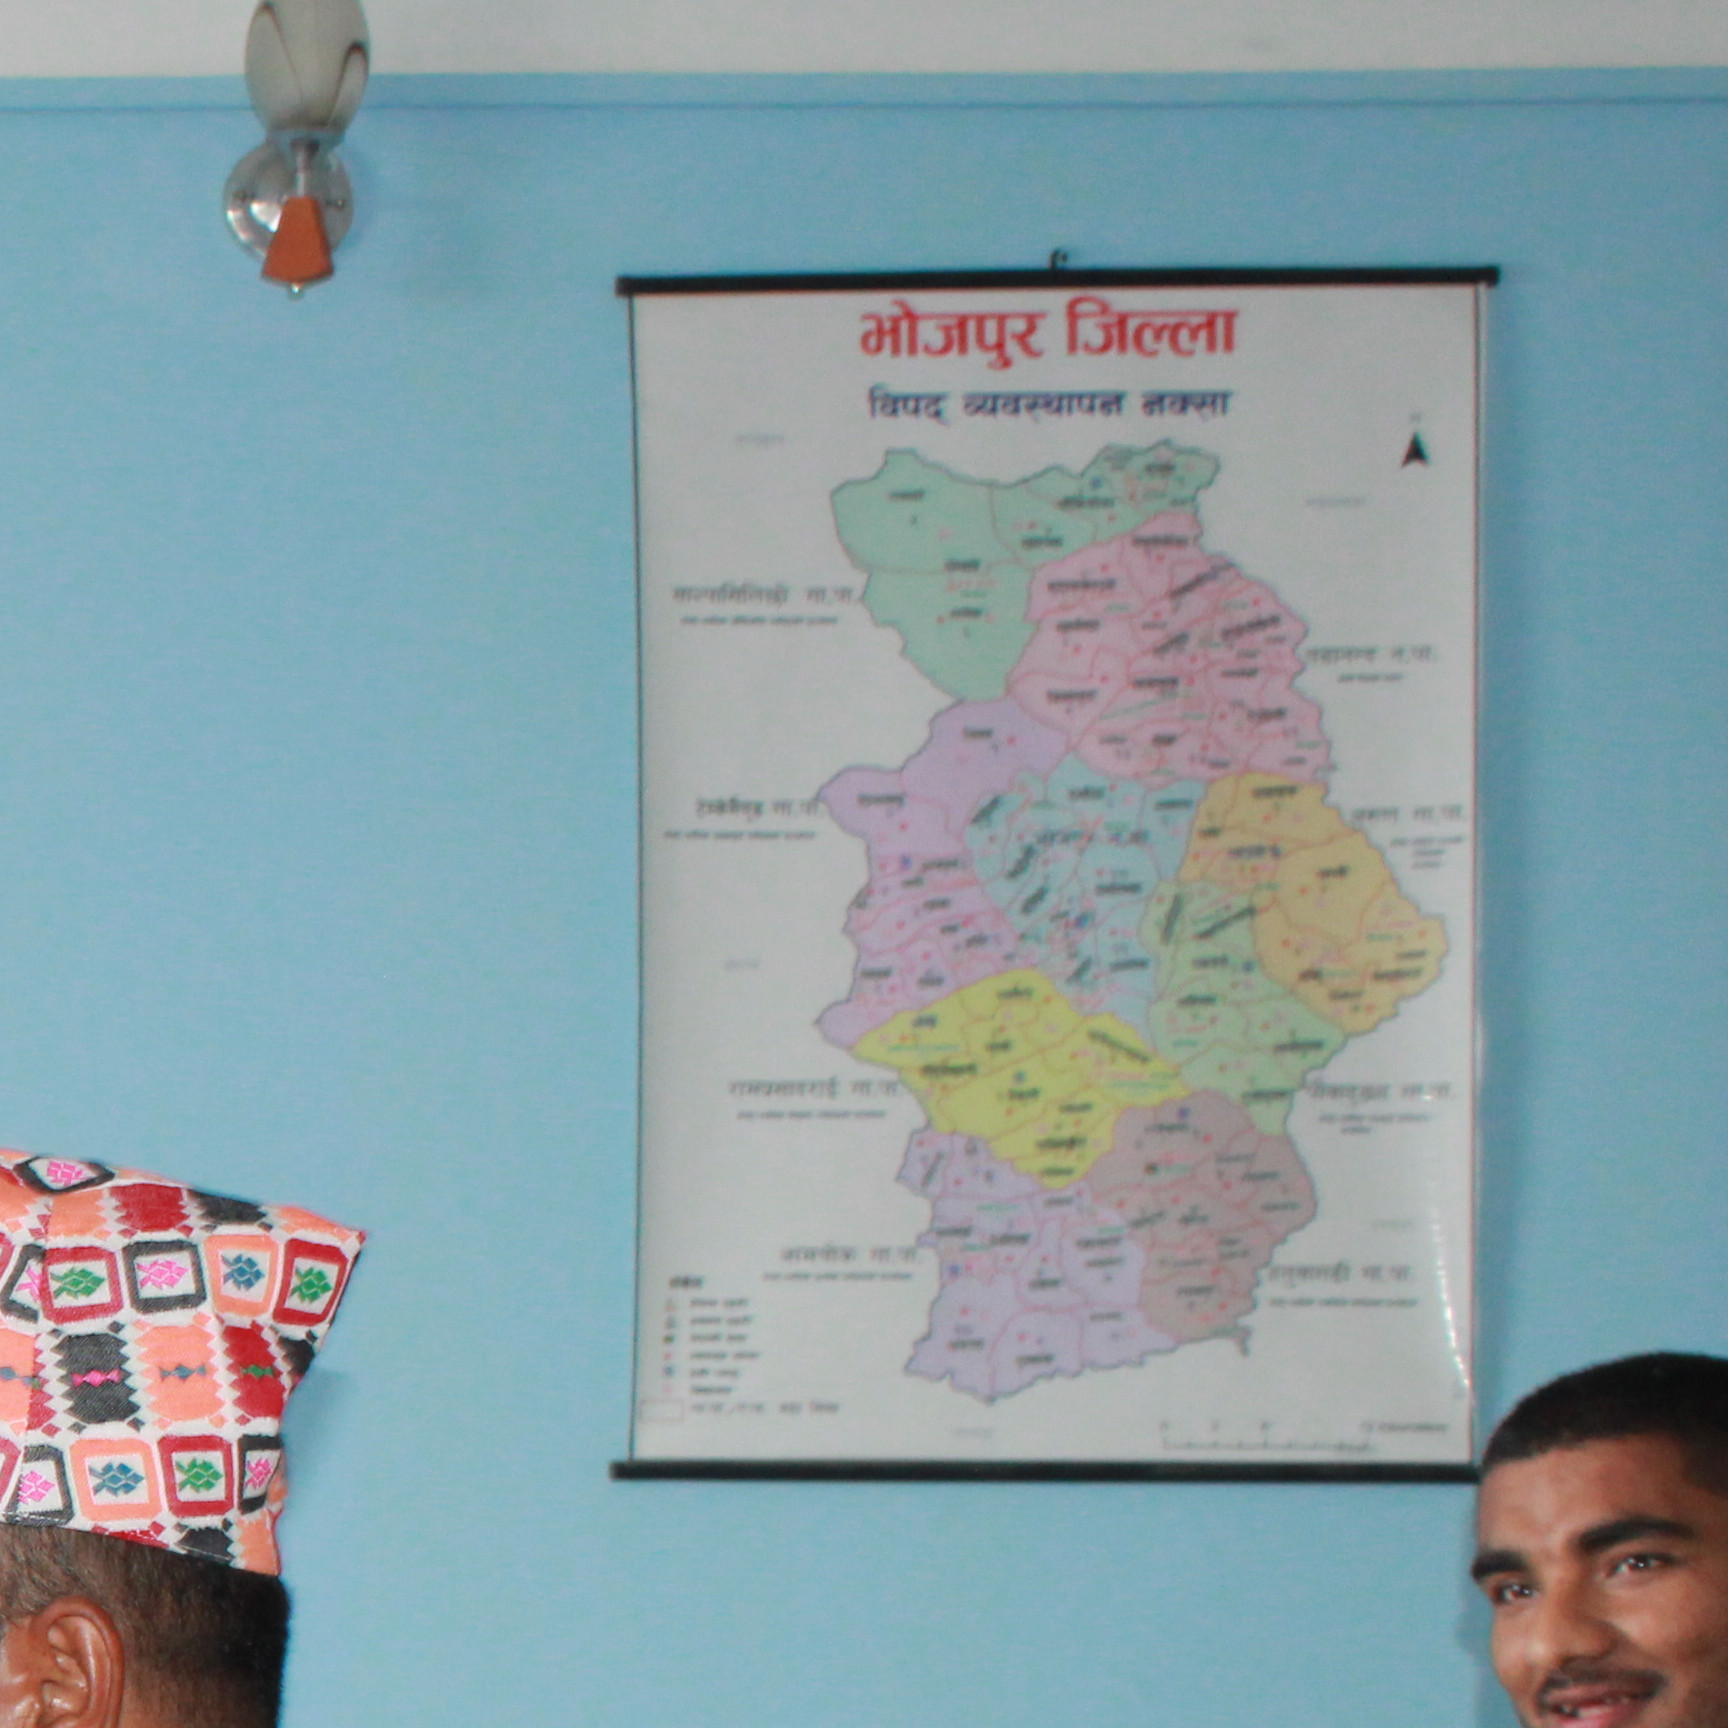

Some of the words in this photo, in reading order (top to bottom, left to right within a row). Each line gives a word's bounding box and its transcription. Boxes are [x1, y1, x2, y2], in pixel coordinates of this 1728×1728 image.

[860, 300, 1046, 370] भोजपुर
[1066, 296, 1238, 357] जिल्ला
[963, 390, 1126, 423] व्यवस्थापन
[1142, 390, 1233, 422] नक्सा
